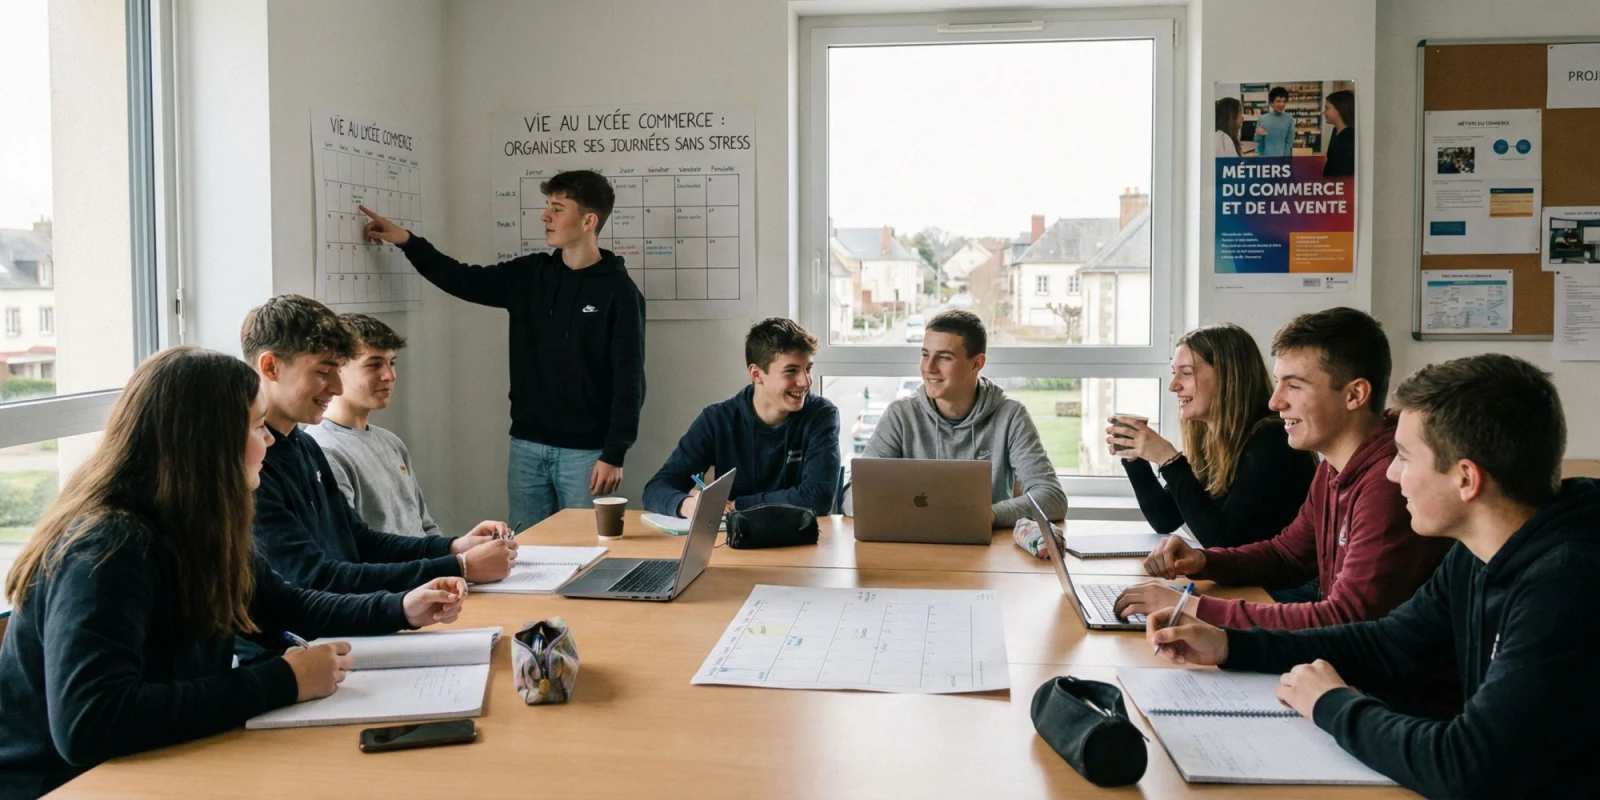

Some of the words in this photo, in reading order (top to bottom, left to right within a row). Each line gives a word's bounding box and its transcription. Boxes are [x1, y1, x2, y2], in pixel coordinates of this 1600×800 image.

[1568, 70, 1600, 82] PROJ
[523, 112, 552, 133] VIE
[559, 115, 580, 132] AU
[587, 108, 632, 131] LYCÉE
[638, 112, 714, 130] COMMERCE
[329, 114, 345, 136] VIE
[347, 120, 359, 139] AU
[360, 122, 381, 144] LYCÉE
[382, 129, 413, 152] COMMERCE
[503, 137, 577, 157] ORGANISER
[583, 138, 606, 153] SES
[610, 132, 671, 153] JOURNÉES
[674, 136, 705, 151] SANS
[708, 134, 751, 150] STRESS
[1222, 161, 1292, 179] MÉTIERS
[1222, 183, 1246, 197] DU
[1249, 182, 1345, 197] COMMERCE
[1222, 201, 1242, 215] ET
[1245, 201, 1266, 215] DE
[1270, 201, 1292, 215] LA
[1293, 200, 1348, 214] VENTE
